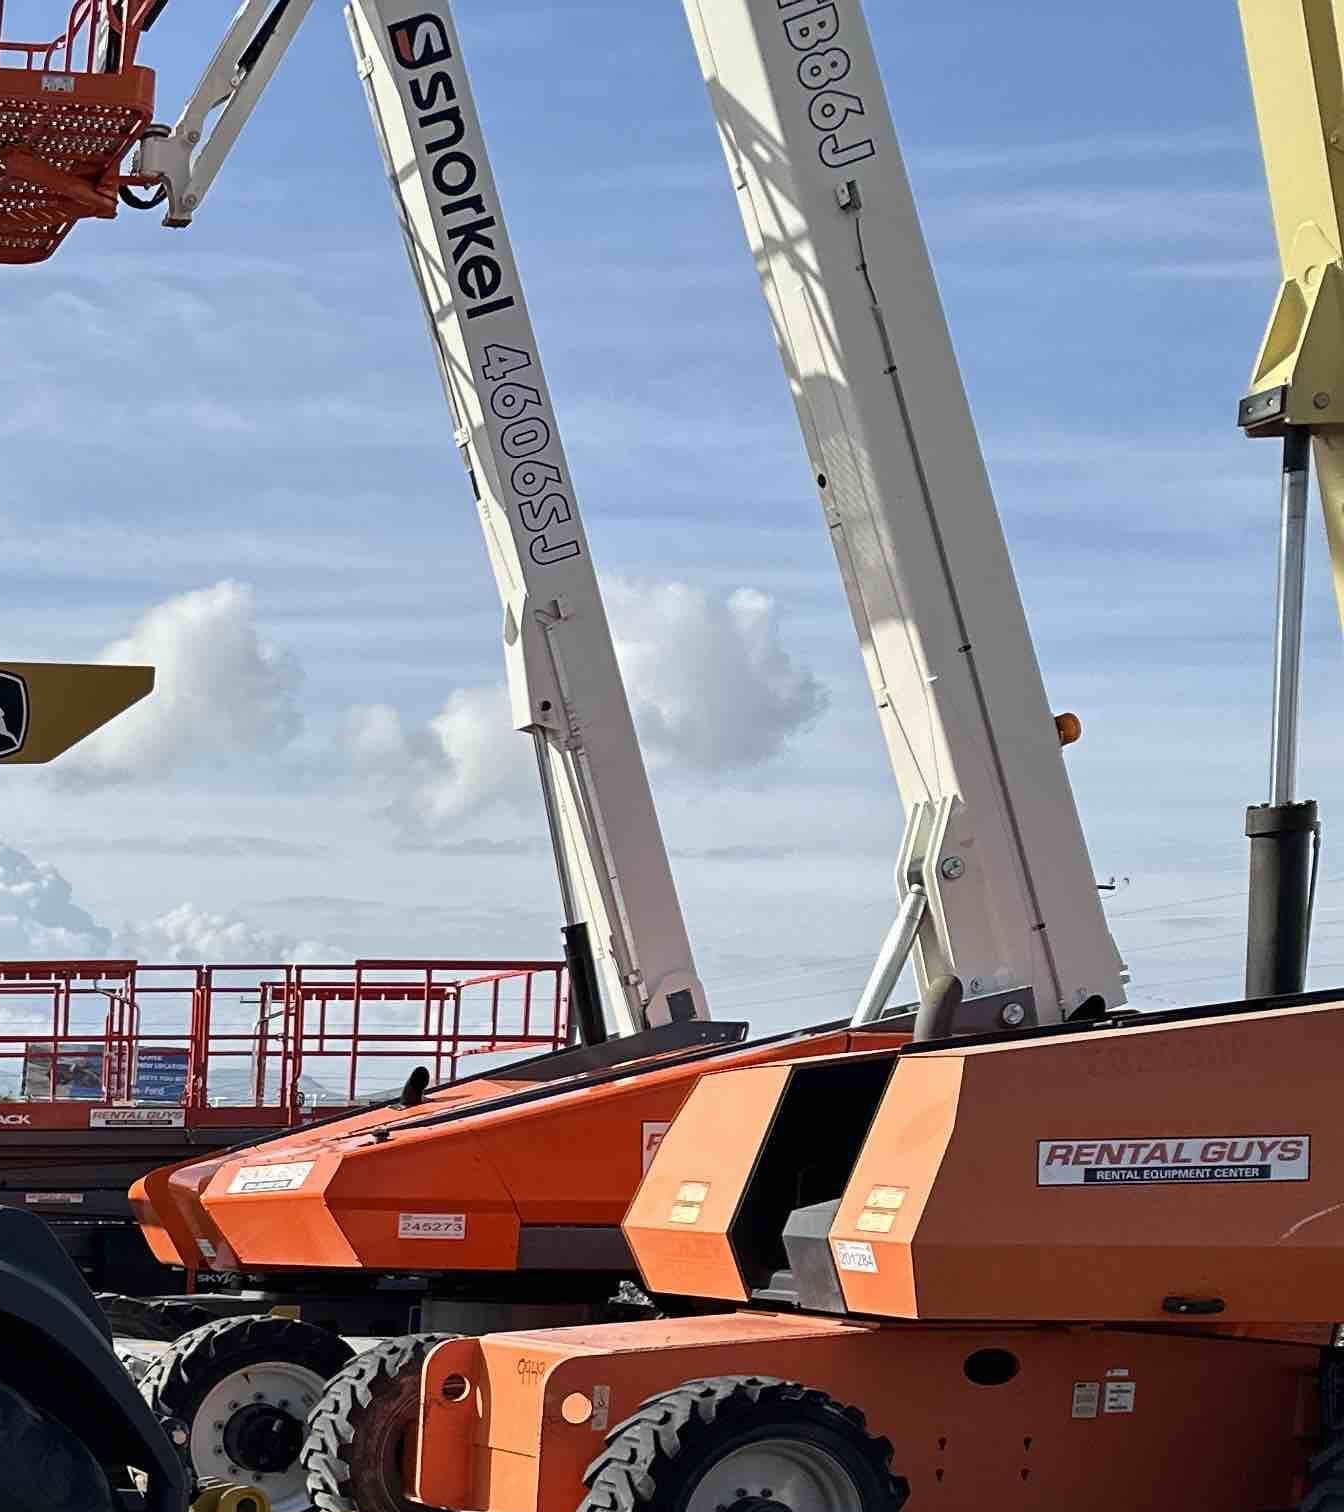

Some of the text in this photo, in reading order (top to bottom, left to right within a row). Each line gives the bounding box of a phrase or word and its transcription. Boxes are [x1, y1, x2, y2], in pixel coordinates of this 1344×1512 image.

[777, 0, 875, 168] B86J
[408, 71, 515, 320] snorkel
[482, 343, 581, 566] 4606SJ
[1045, 1139, 1304, 1167] RENTAL GUYS
[1095, 1166, 1260, 1181] RENTAL EQUIPMENT CENTER
